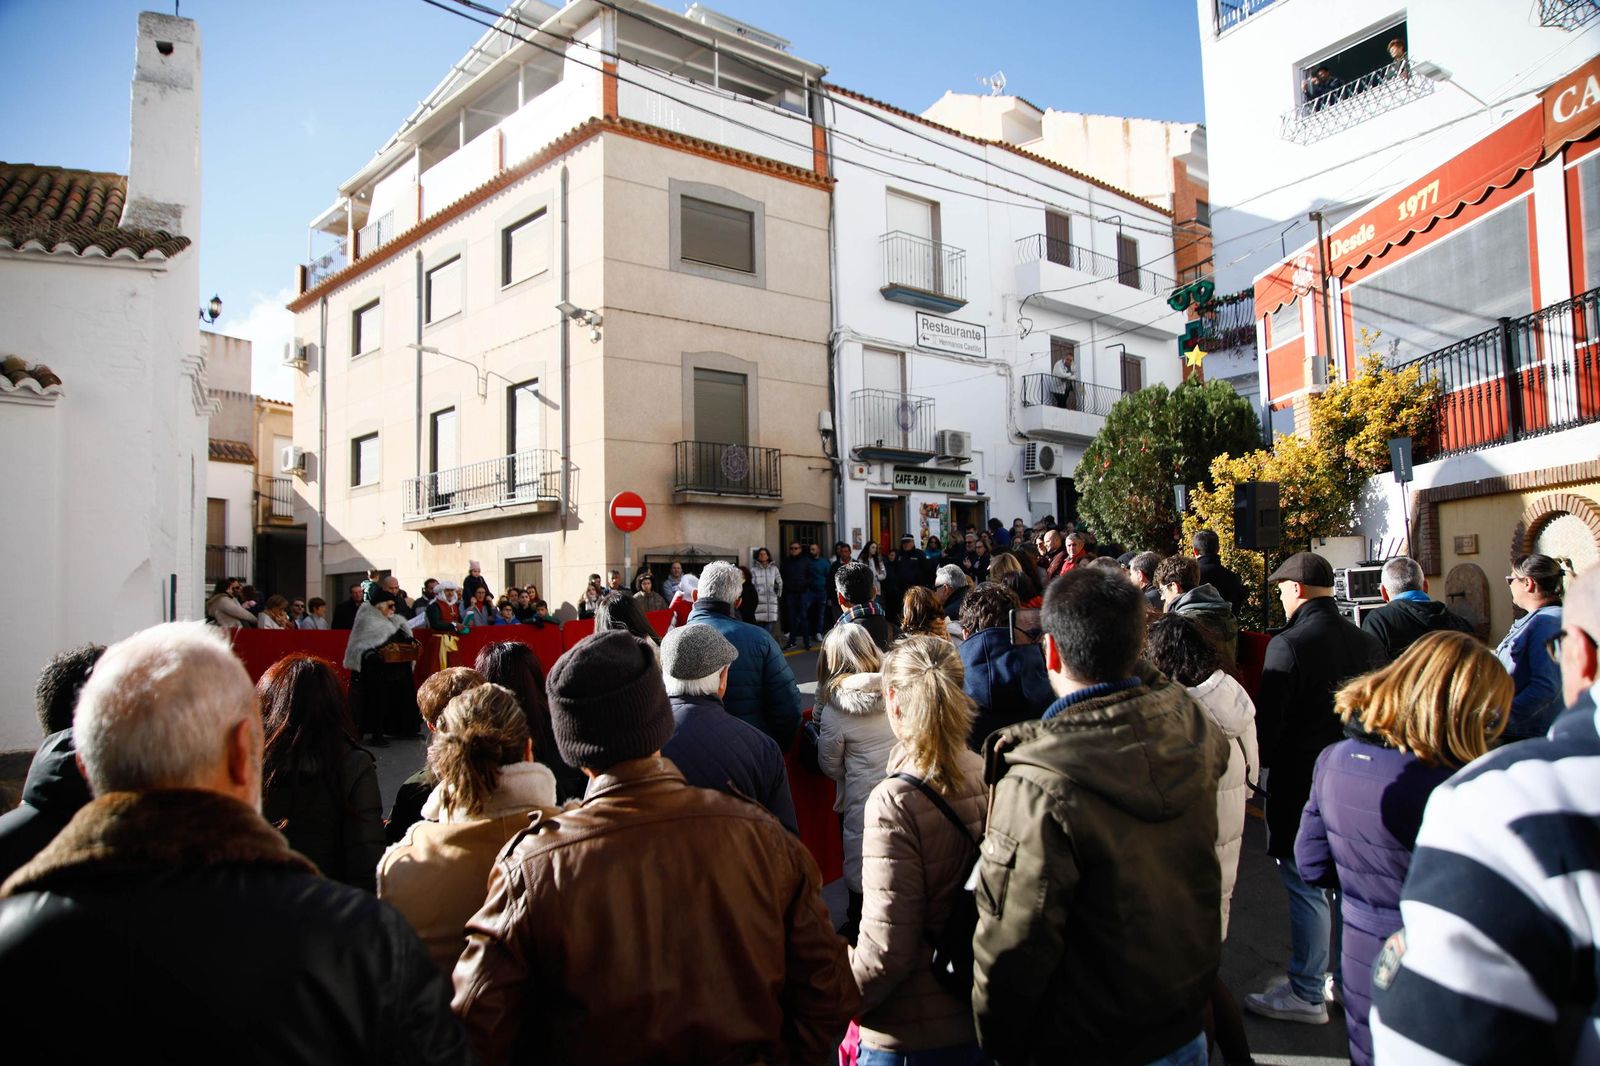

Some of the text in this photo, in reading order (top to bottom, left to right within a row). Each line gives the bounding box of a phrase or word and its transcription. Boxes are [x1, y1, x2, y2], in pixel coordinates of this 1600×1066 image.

[1330, 179, 1440, 262] Desde 1977
[922, 318, 981, 341] Restaurante
[895, 474, 927, 487] CAFE-BAR
